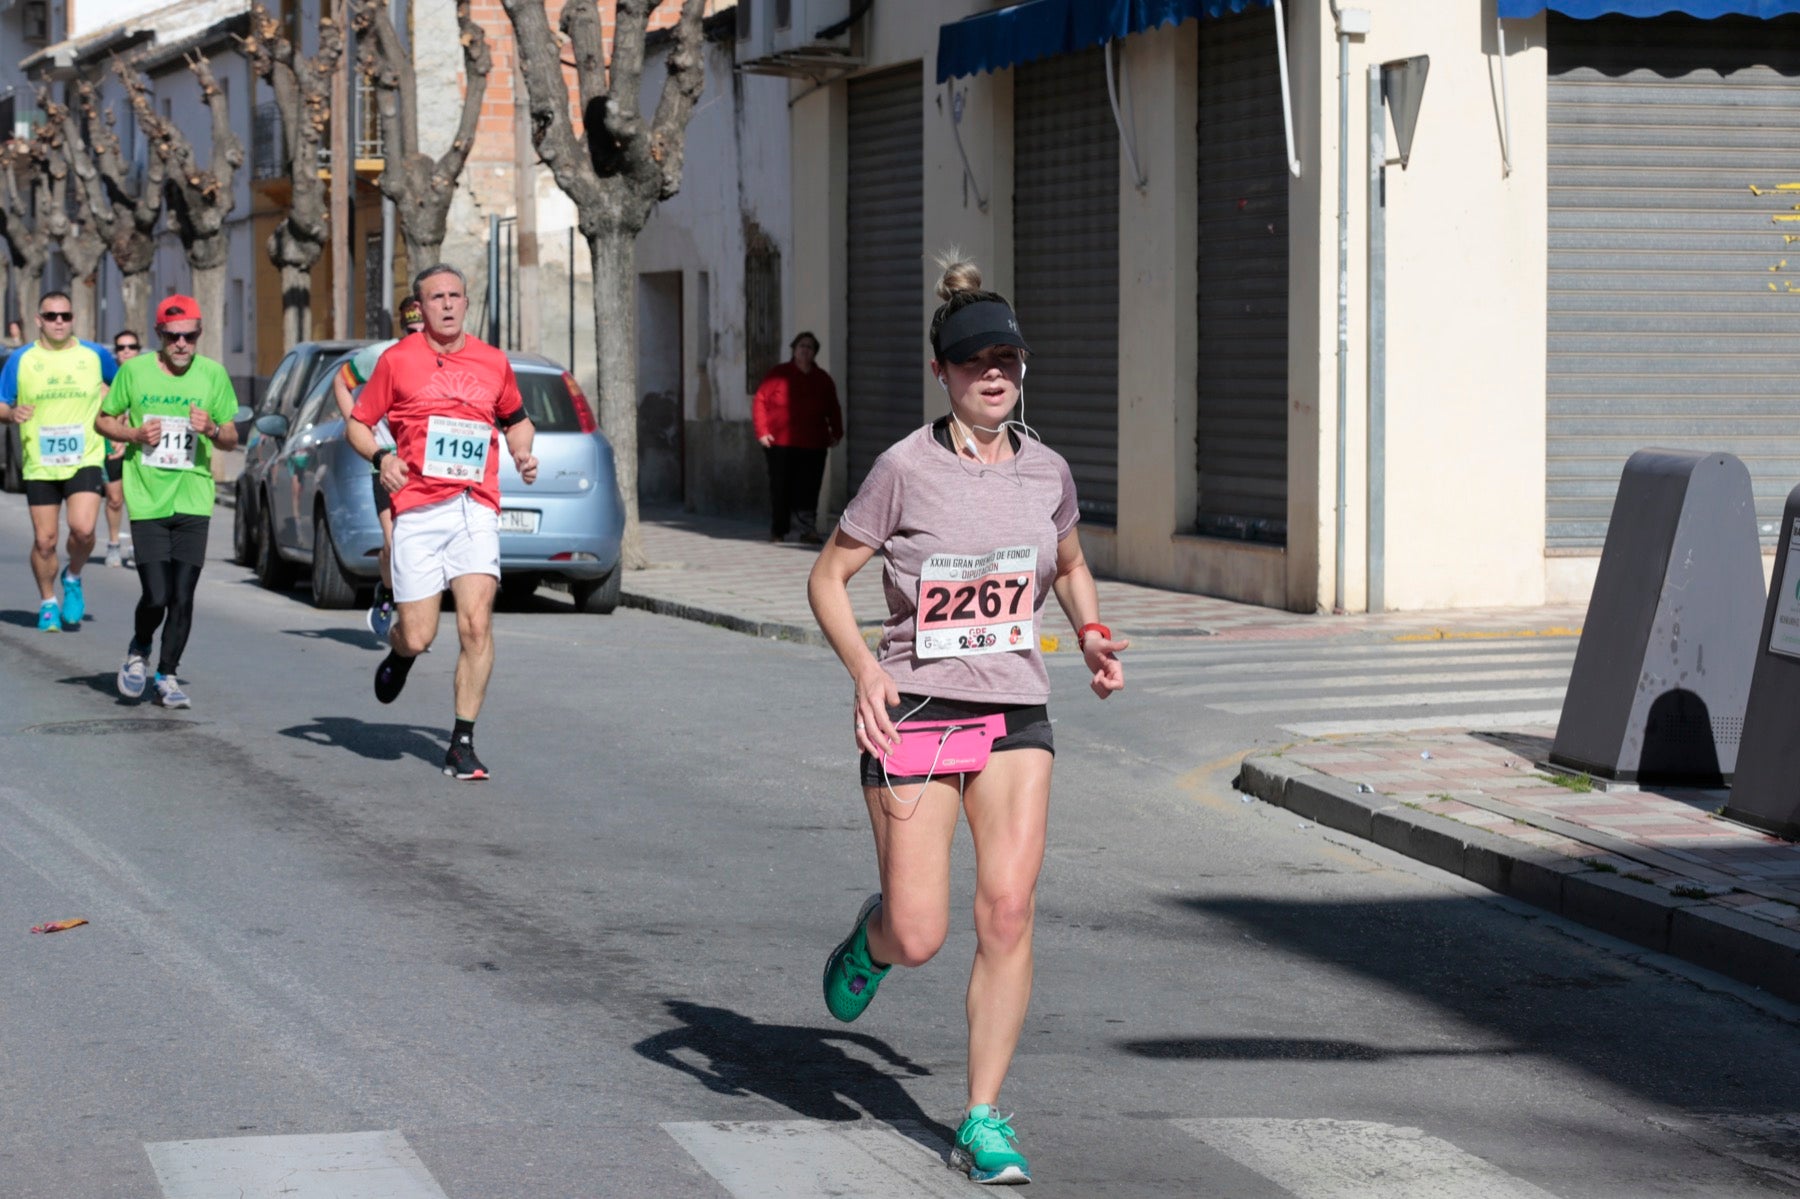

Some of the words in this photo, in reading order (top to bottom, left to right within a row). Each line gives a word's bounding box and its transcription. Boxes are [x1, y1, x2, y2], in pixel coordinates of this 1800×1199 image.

[47, 438, 78, 453] 750
[161, 433, 193, 449] 112
[435, 437, 484, 461] 1194
[930, 558, 951, 567] XXXIII
[952, 558, 974, 568] GRAN
[974, 553, 996, 568] PREMIO
[996, 551, 1005, 560] DE
[1006, 549, 1031, 559] FONDO
[924, 577, 1030, 623] 2267
